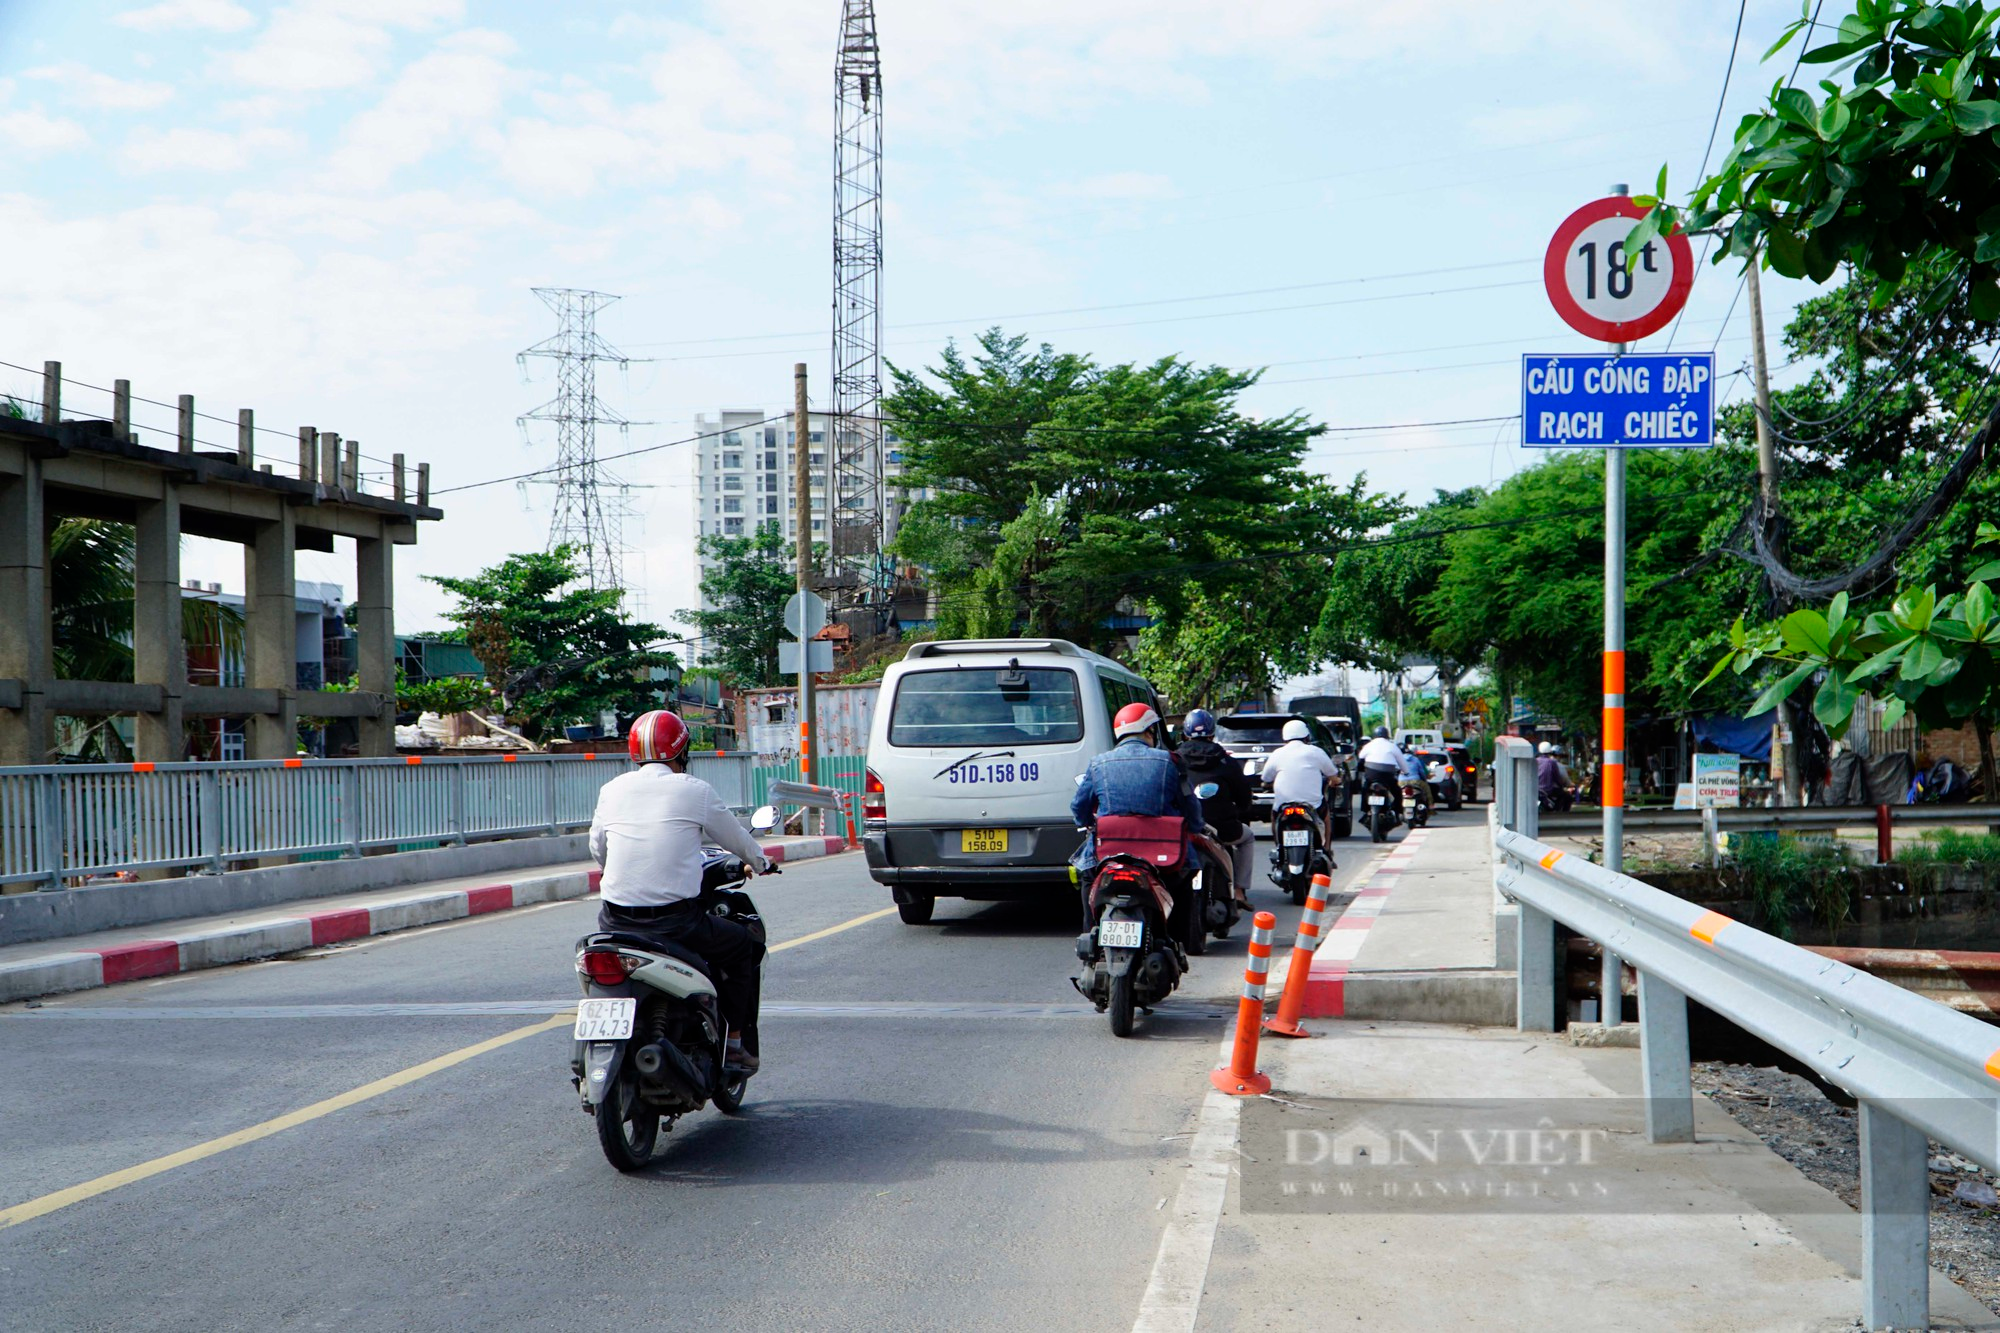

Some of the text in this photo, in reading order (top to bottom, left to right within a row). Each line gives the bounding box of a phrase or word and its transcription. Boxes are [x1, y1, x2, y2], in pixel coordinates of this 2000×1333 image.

[1527, 358, 1709, 399] CẦU CỐNG ĐẬP
[1539, 401, 1699, 444] RẠCH CHIẾC
[1020, 763, 1039, 781] 09
[975, 830, 995, 840] 51D
[968, 840, 1003, 851] 158.09
[1102, 934, 1139, 946] 980.03
[587, 1002, 625, 1018] 62-F1
[579, 1019, 629, 1038] 074.73
